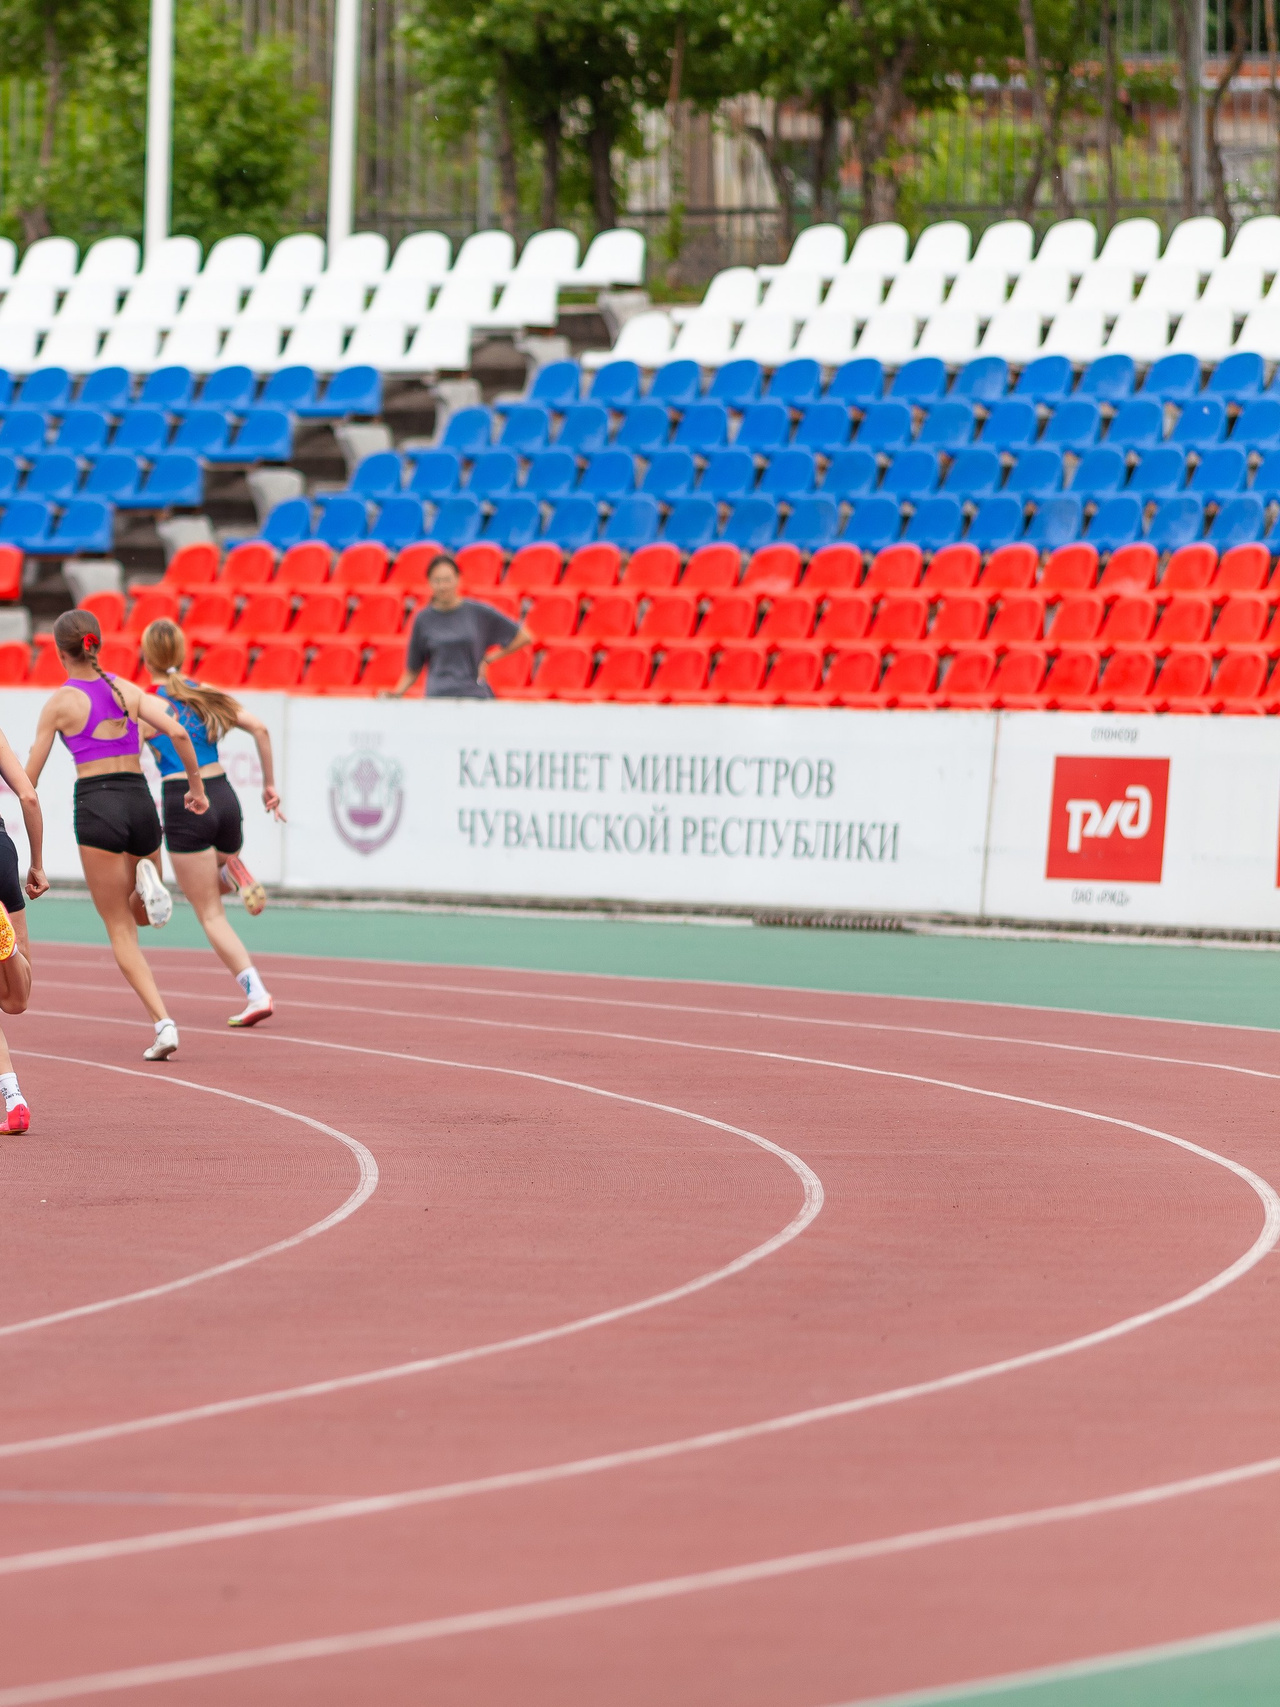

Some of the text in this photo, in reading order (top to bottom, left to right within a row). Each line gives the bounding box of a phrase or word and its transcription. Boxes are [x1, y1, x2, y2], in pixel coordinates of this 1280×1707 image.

[458, 748, 836, 799] КАБИНЕТ МИНИСТРОВ
[457, 804, 900, 862] ЧУВАШСКОЙ РЕСПУБЛИКИ
